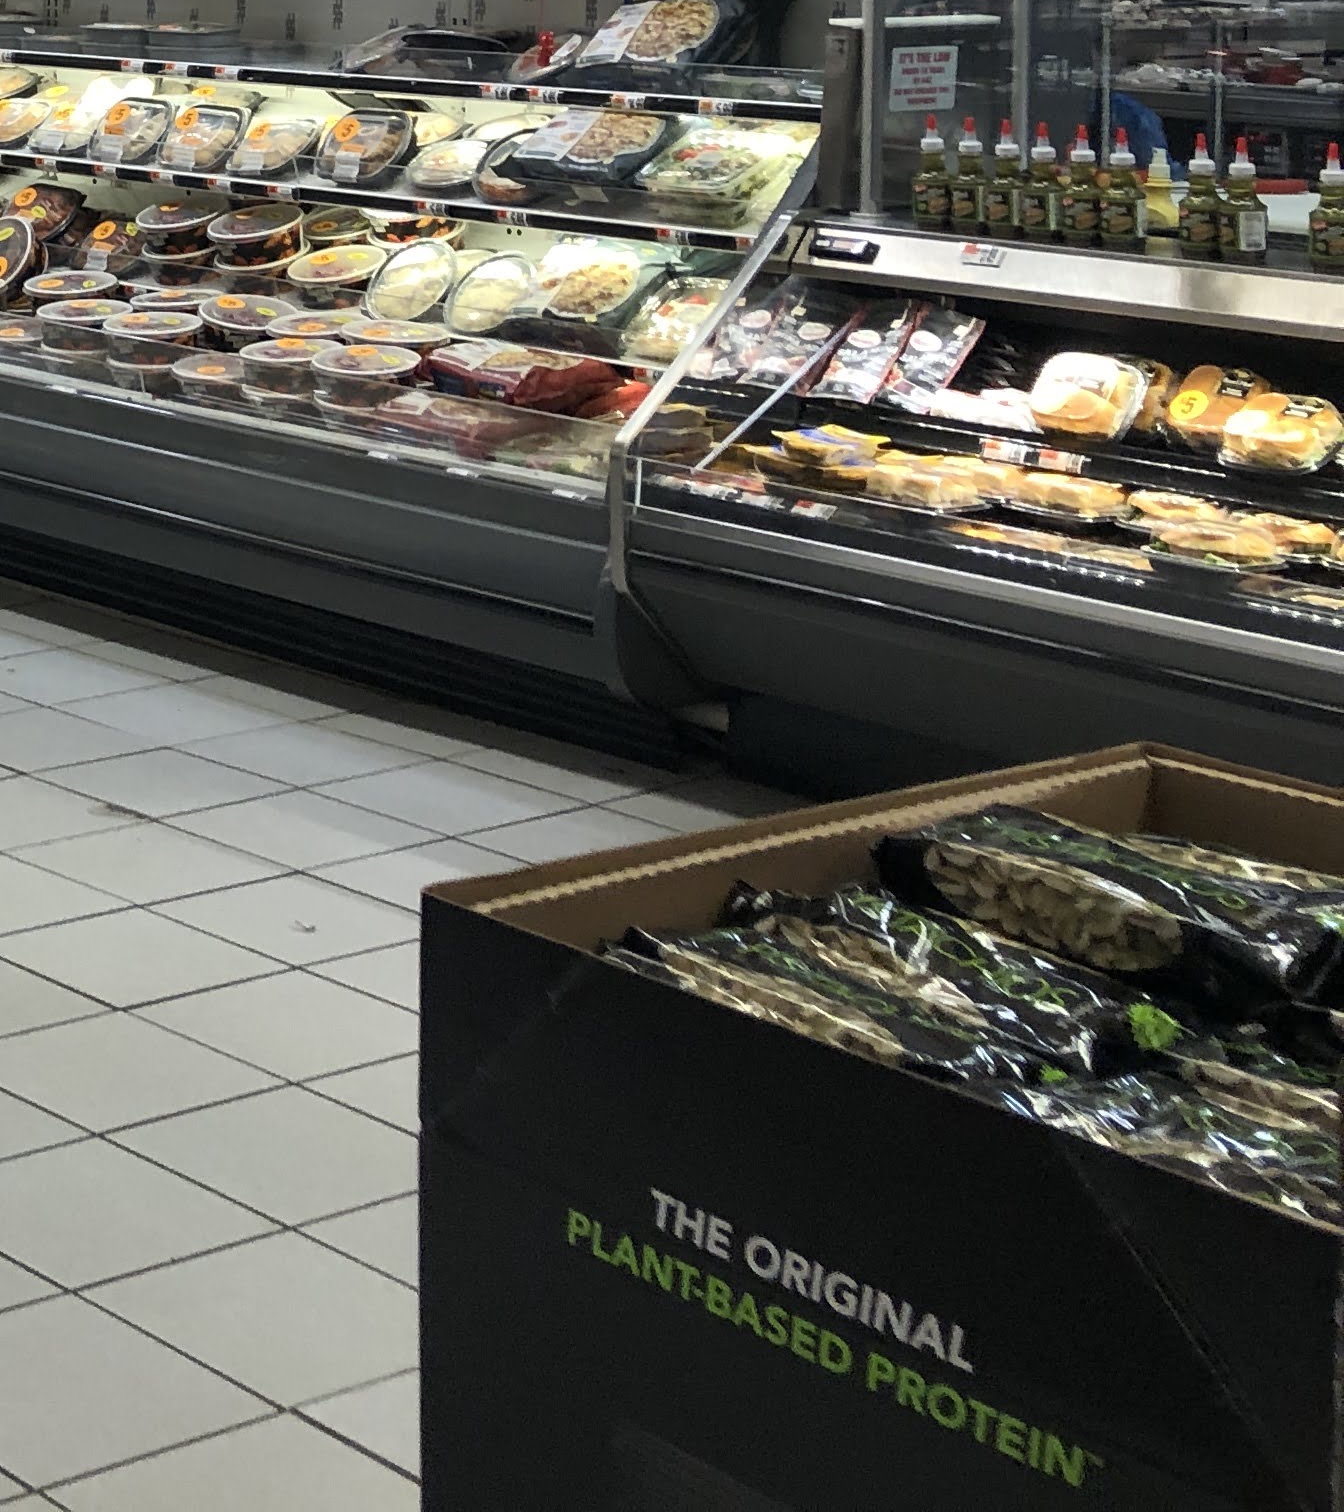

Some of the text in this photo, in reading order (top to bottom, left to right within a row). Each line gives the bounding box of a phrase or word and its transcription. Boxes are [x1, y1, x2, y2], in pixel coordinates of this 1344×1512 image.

[566, 1206, 852, 1376] PLANT-BASED
[650, 1185, 975, 1375] THE ORIGINAL
